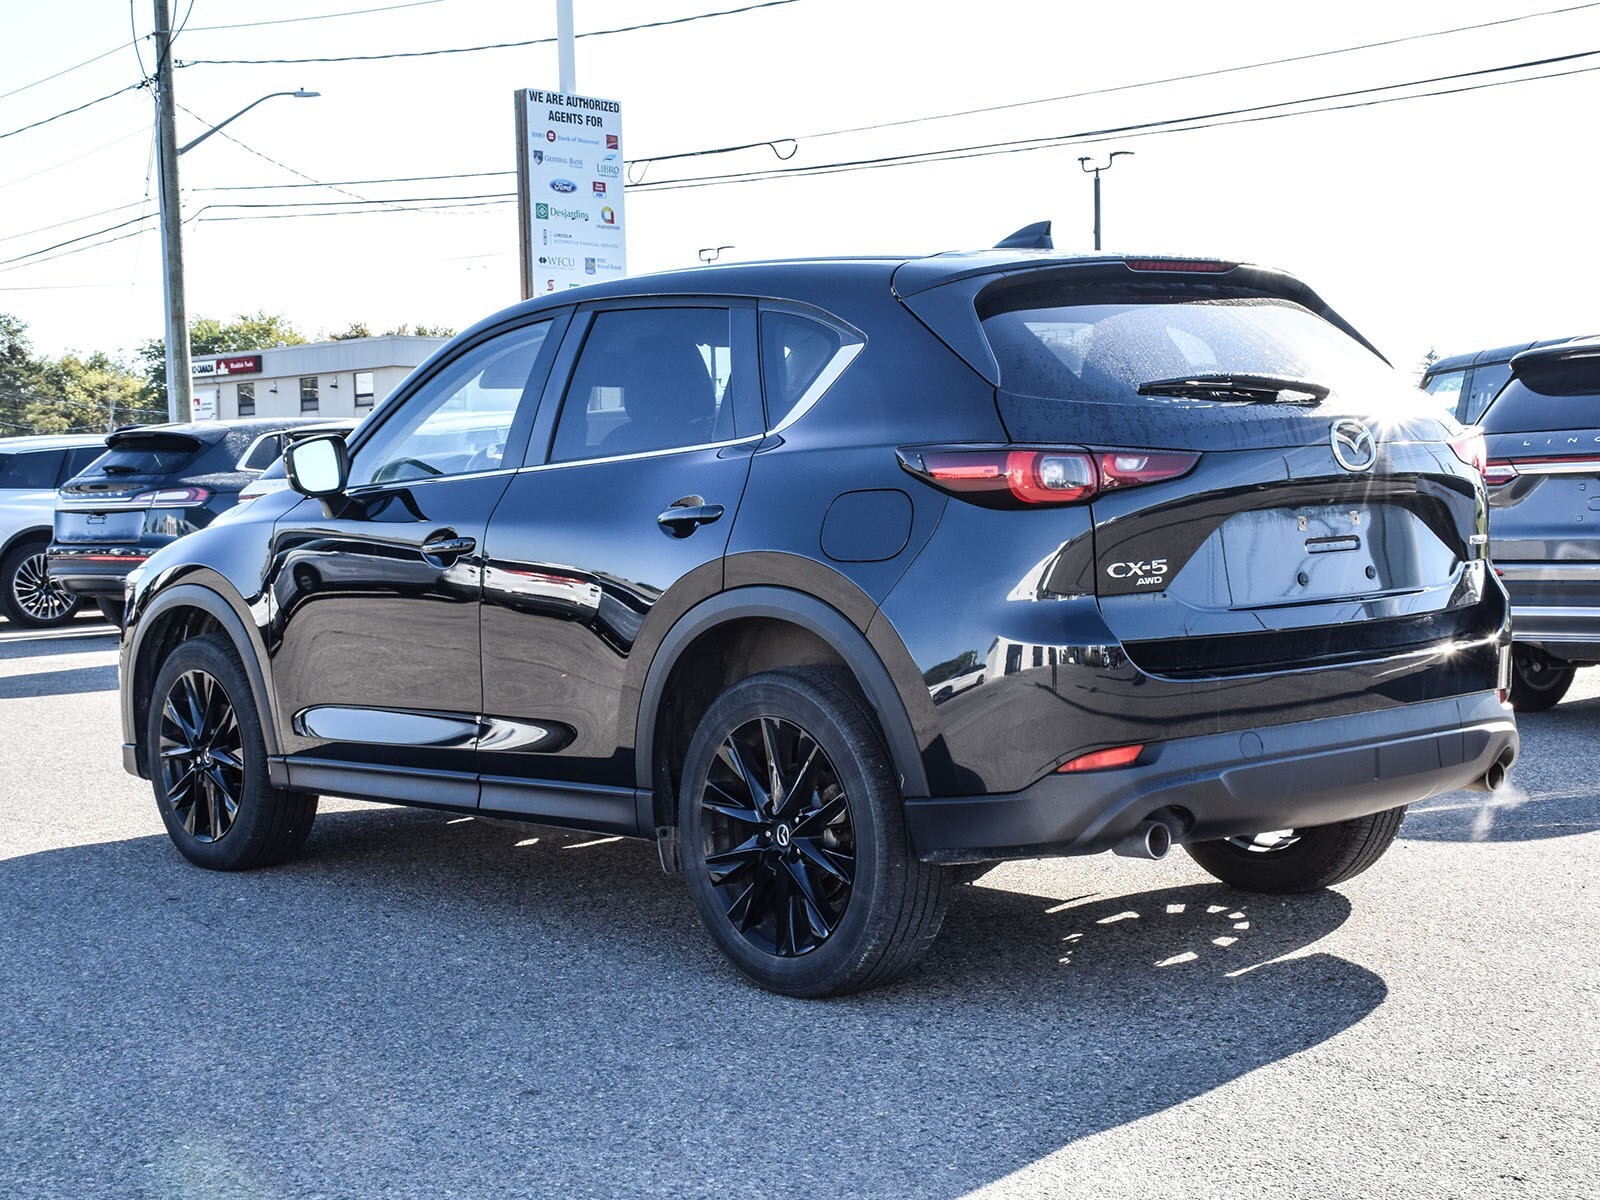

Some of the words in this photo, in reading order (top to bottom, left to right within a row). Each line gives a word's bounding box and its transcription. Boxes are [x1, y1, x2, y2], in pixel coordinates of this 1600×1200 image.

[529, 90, 543, 102] WE
[546, 93, 564, 105] ARE
[566, 96, 620, 113] AUTHORIZED
[548, 110, 583, 125] AGENTS
[586, 115, 603, 127] FOR
[596, 163, 620, 175] LIBRO
[550, 207, 589, 219] Desjardins
[547, 256, 575, 267] WFCU
[1106, 558, 1168, 578] CX-5
[1136, 576, 1163, 586] AWD
